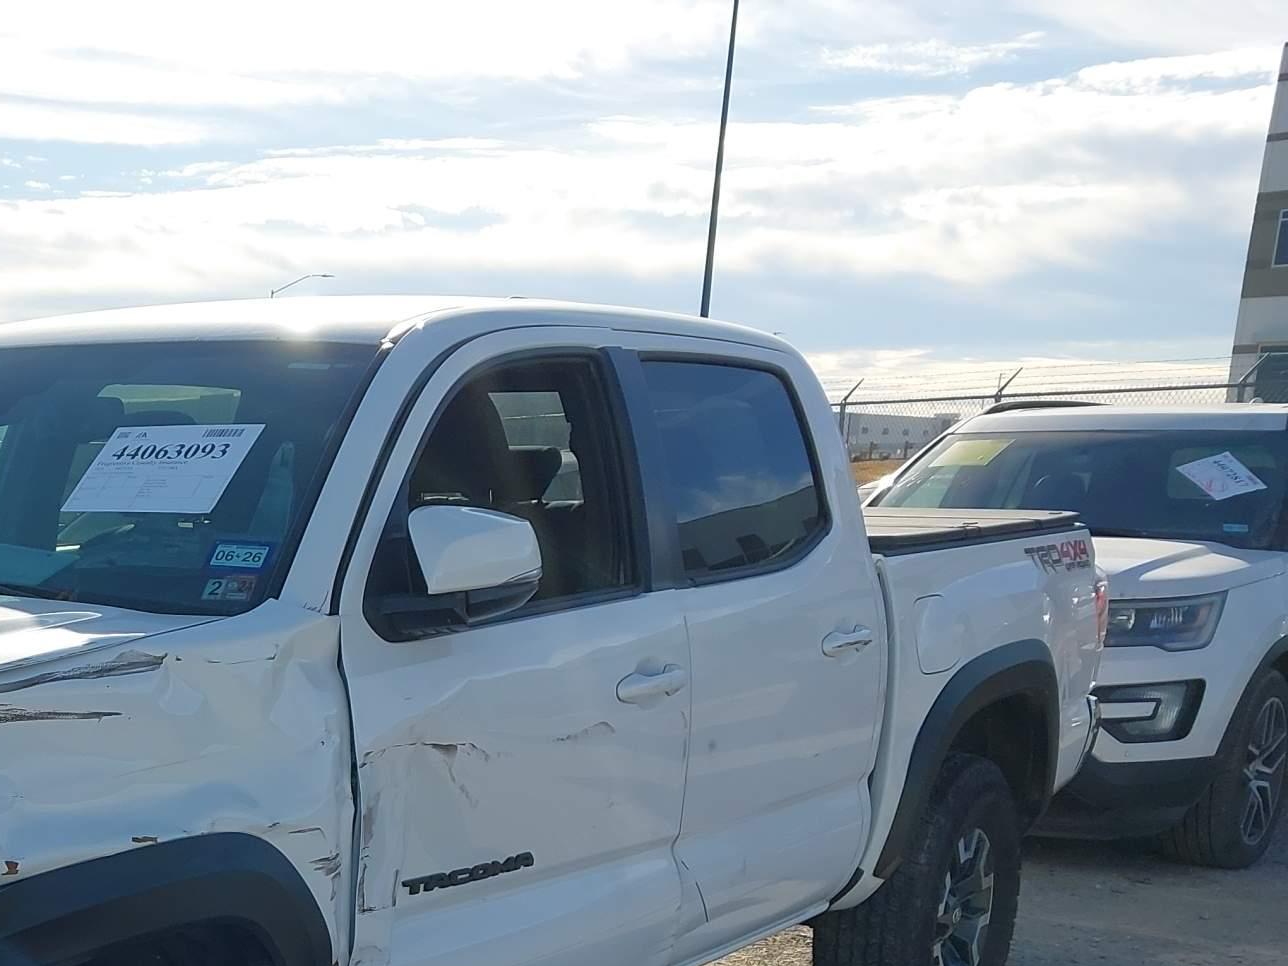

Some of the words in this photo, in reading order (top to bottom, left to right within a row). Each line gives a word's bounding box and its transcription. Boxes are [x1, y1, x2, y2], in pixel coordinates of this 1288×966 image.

[112, 443, 231, 460] 44063093
[215, 550, 235, 562] 06
[241, 551, 263, 563] 26
[1024, 544, 1064, 575] TRD
[208, 581, 222, 596] 2
[401, 851, 535, 895] TACOMA
